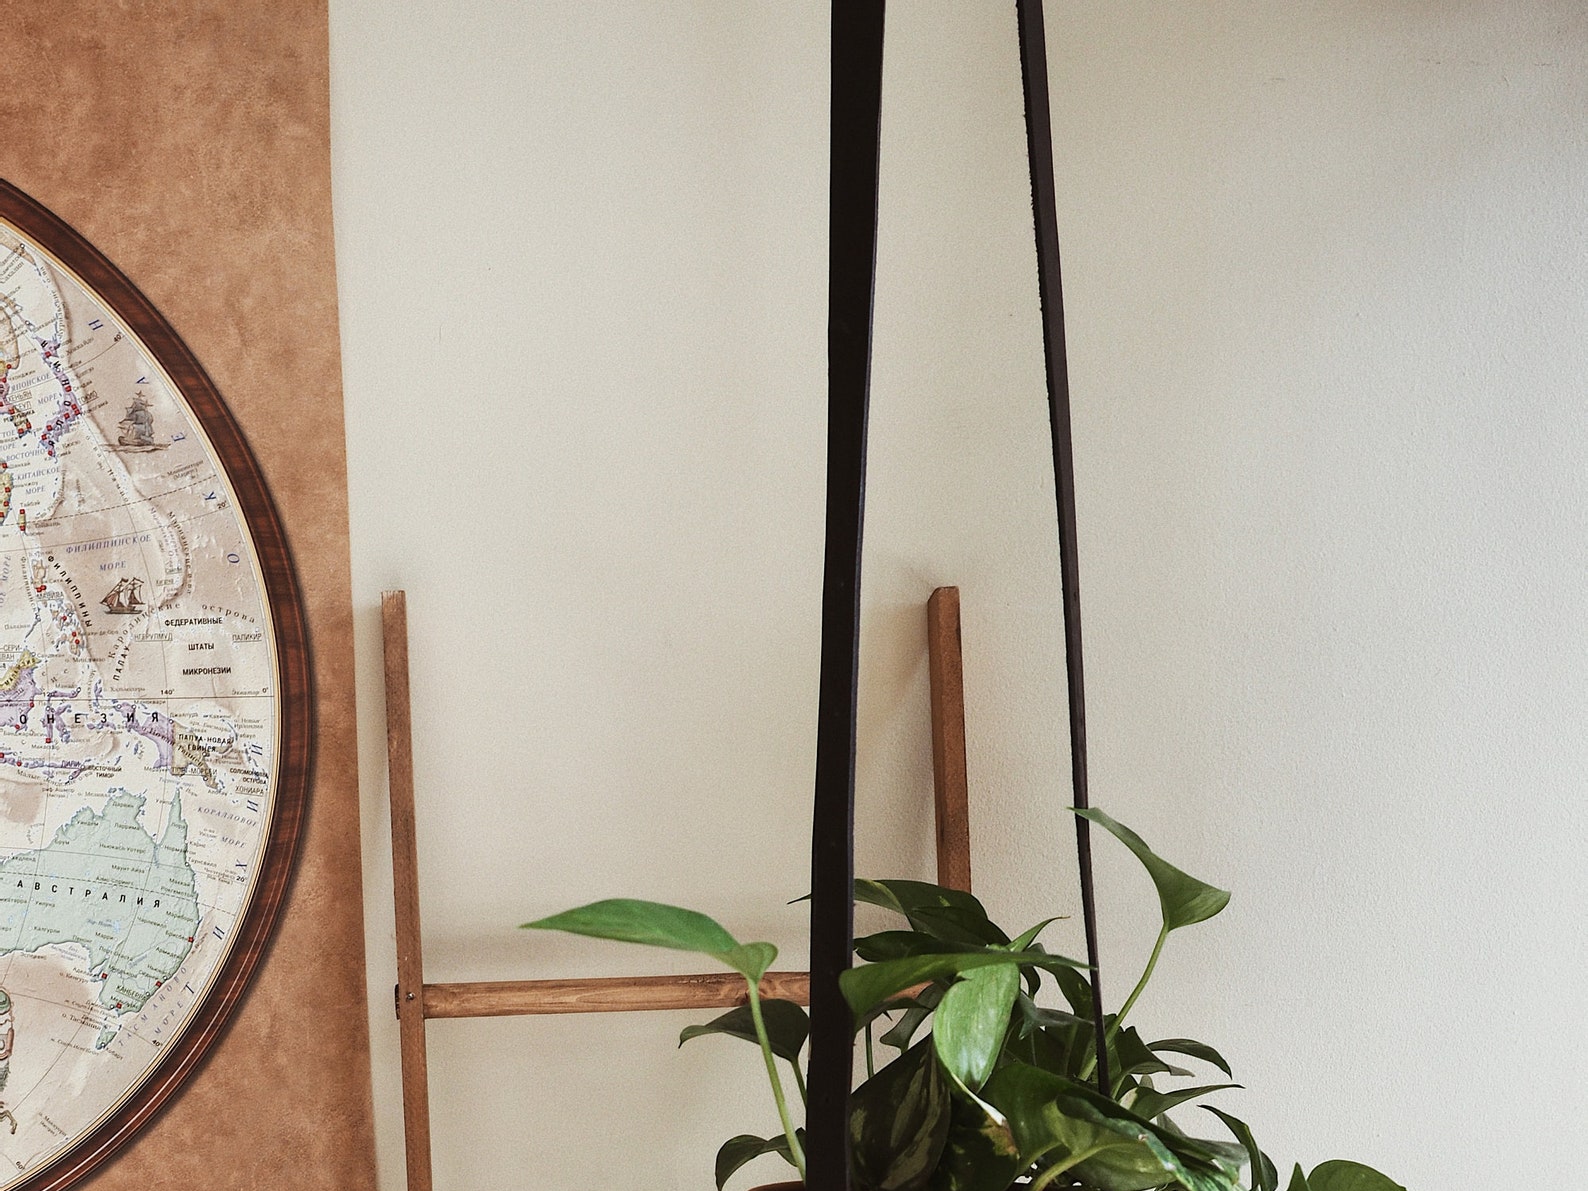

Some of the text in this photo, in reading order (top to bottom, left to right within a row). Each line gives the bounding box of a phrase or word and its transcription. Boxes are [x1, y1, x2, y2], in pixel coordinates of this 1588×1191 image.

[100, 560, 127, 571] МОРЕ
[164, 617, 223, 627] ФЕДЕРАТИВНЫЕ
[188, 643, 215, 651] ШТАТЫ
[113, 646, 130, 681] ПАЛАУ
[182, 667, 232, 676] МИКРОНЕЗИИ
[17, 879, 160, 908] АВСТРАЛИЯ
